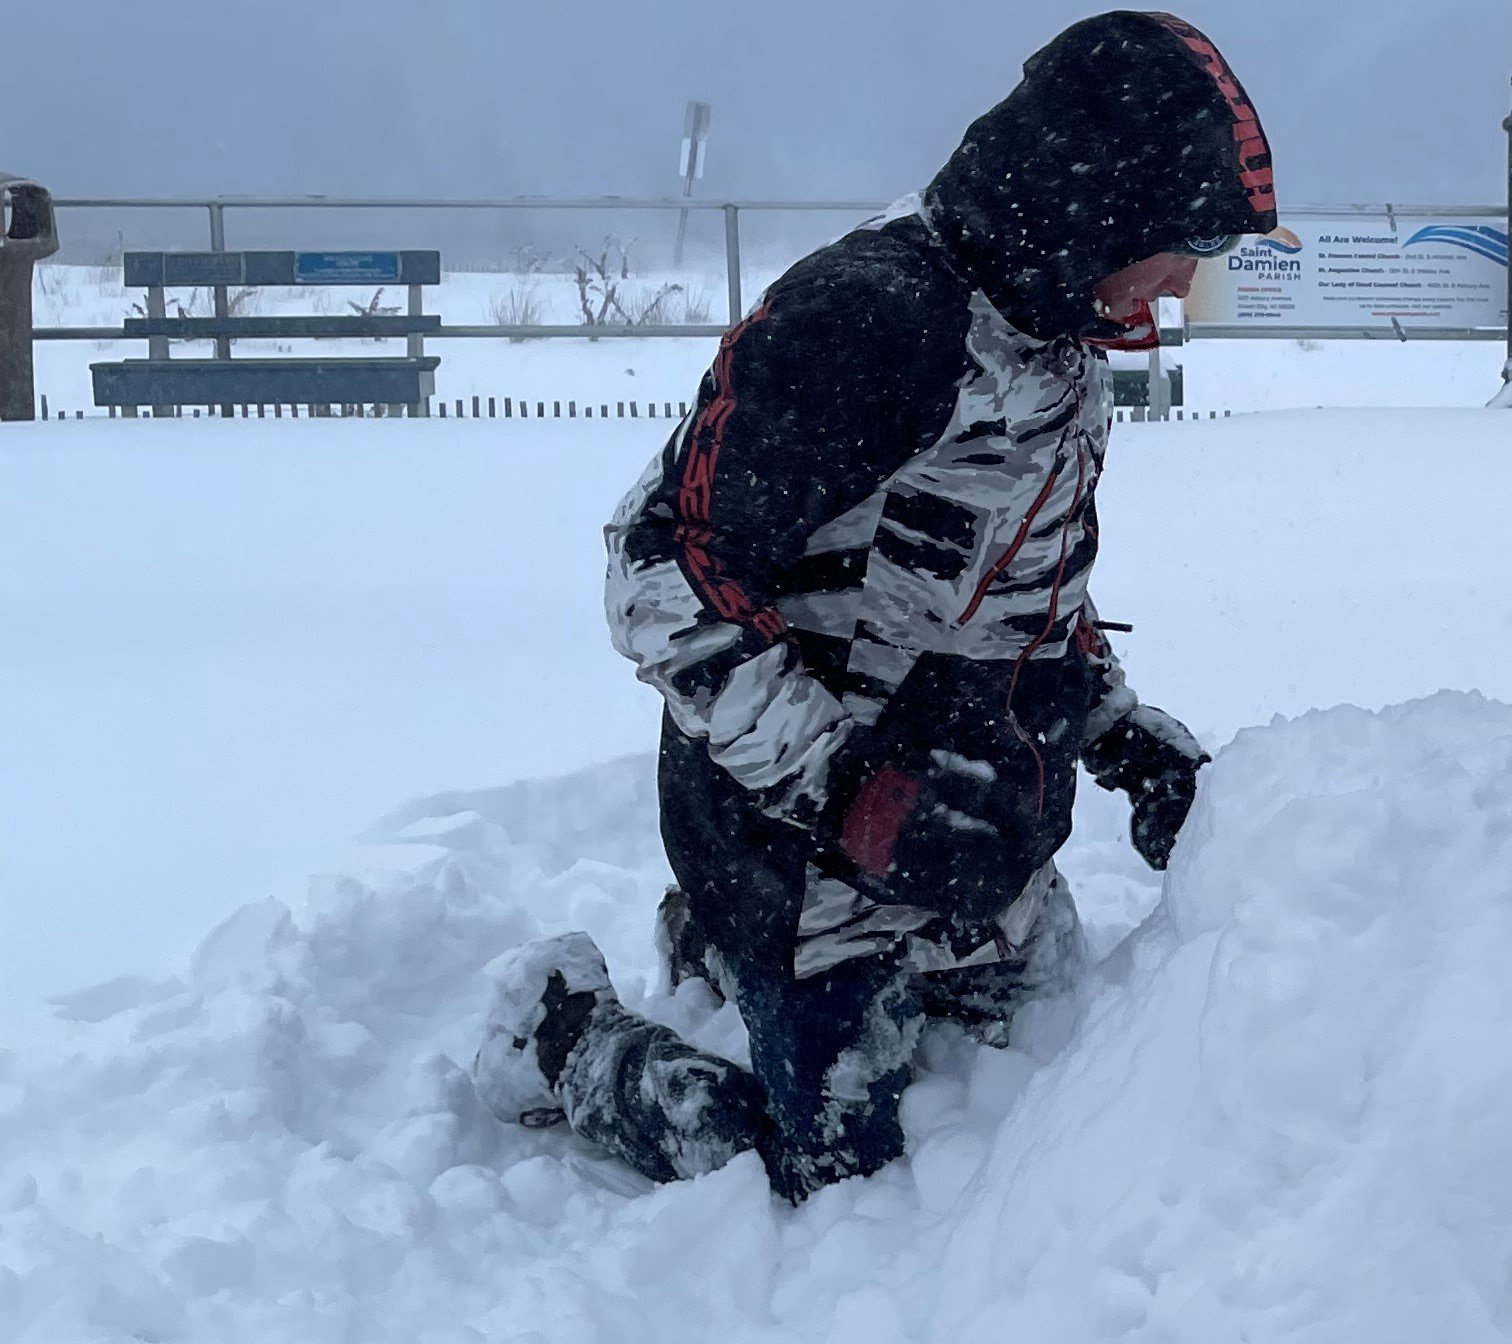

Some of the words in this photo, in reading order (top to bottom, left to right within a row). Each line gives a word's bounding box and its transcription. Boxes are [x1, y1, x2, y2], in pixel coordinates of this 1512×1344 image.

[1352, 236, 1398, 244] Welcome!
[1240, 247, 1273, 257] Saint
[1228, 255, 1301, 271] Damien
[1258, 272, 1301, 281] PARISH
